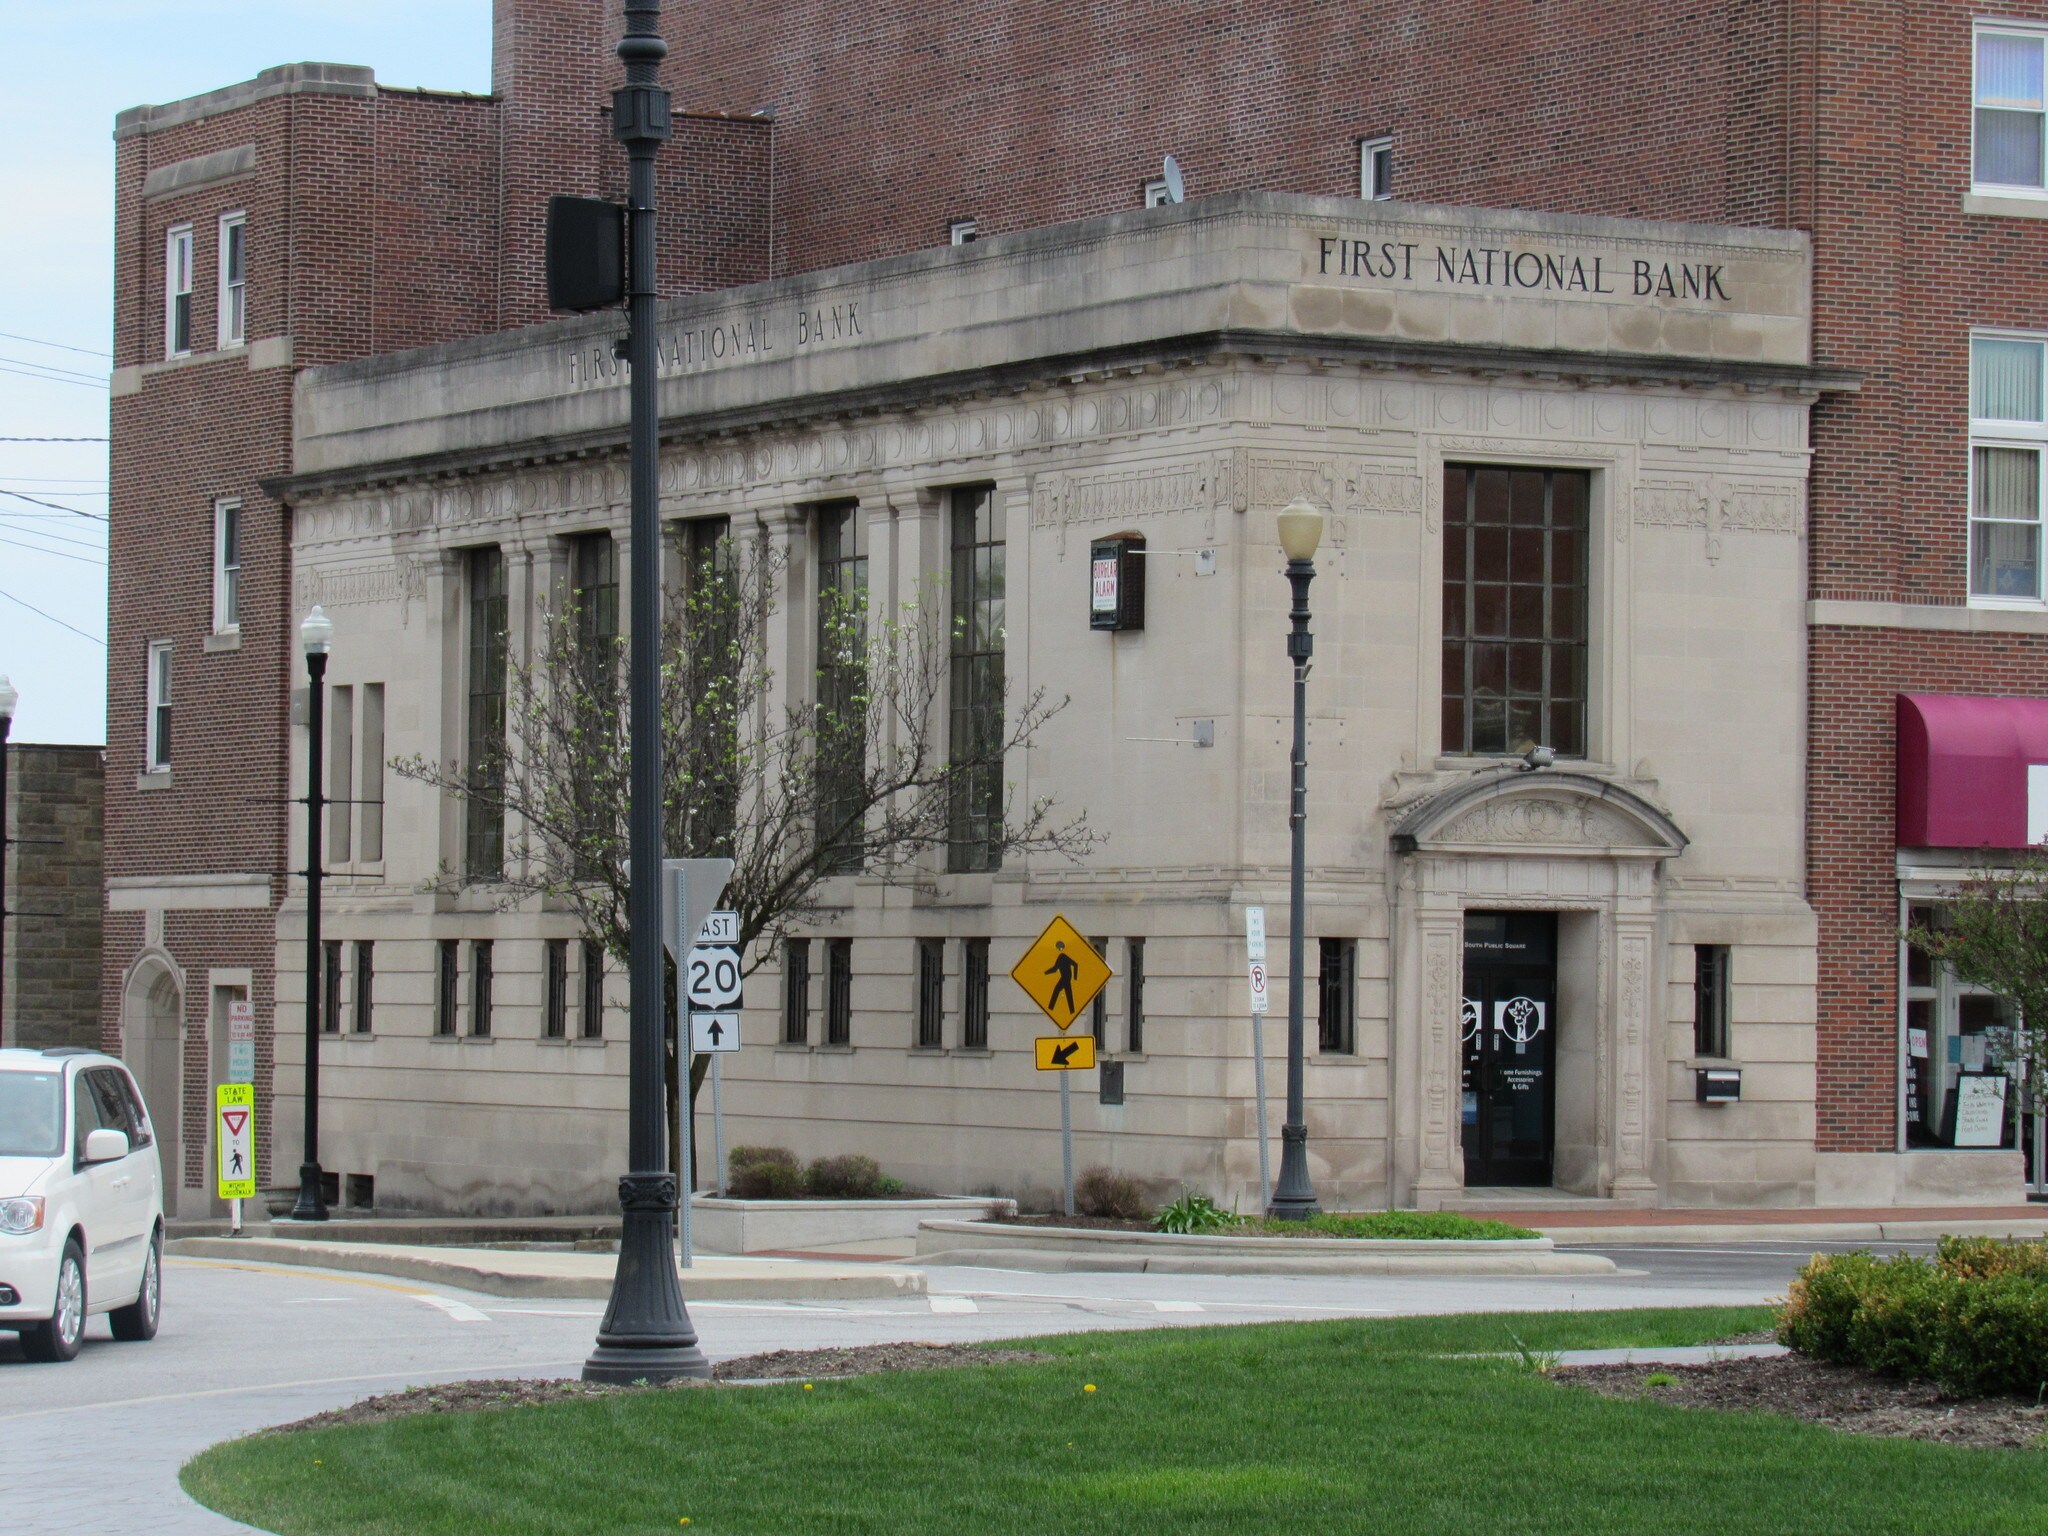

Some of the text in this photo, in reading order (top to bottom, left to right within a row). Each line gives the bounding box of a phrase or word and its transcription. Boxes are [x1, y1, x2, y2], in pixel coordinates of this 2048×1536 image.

[1317, 236, 1732, 301] FIRST NATIONAL BANK
[569, 302, 863, 384] FIRS NATIONAL BANK
[1095, 580, 1115, 597] ALARM
[701, 918, 730, 936] AST
[691, 959, 737, 994] 20
[236, 1004, 247, 1012] NO
[1912, 1036, 1926, 1048] OPEN
[223, 1087, 247, 1096] STATE
[227, 1096, 243, 1104] LAW
